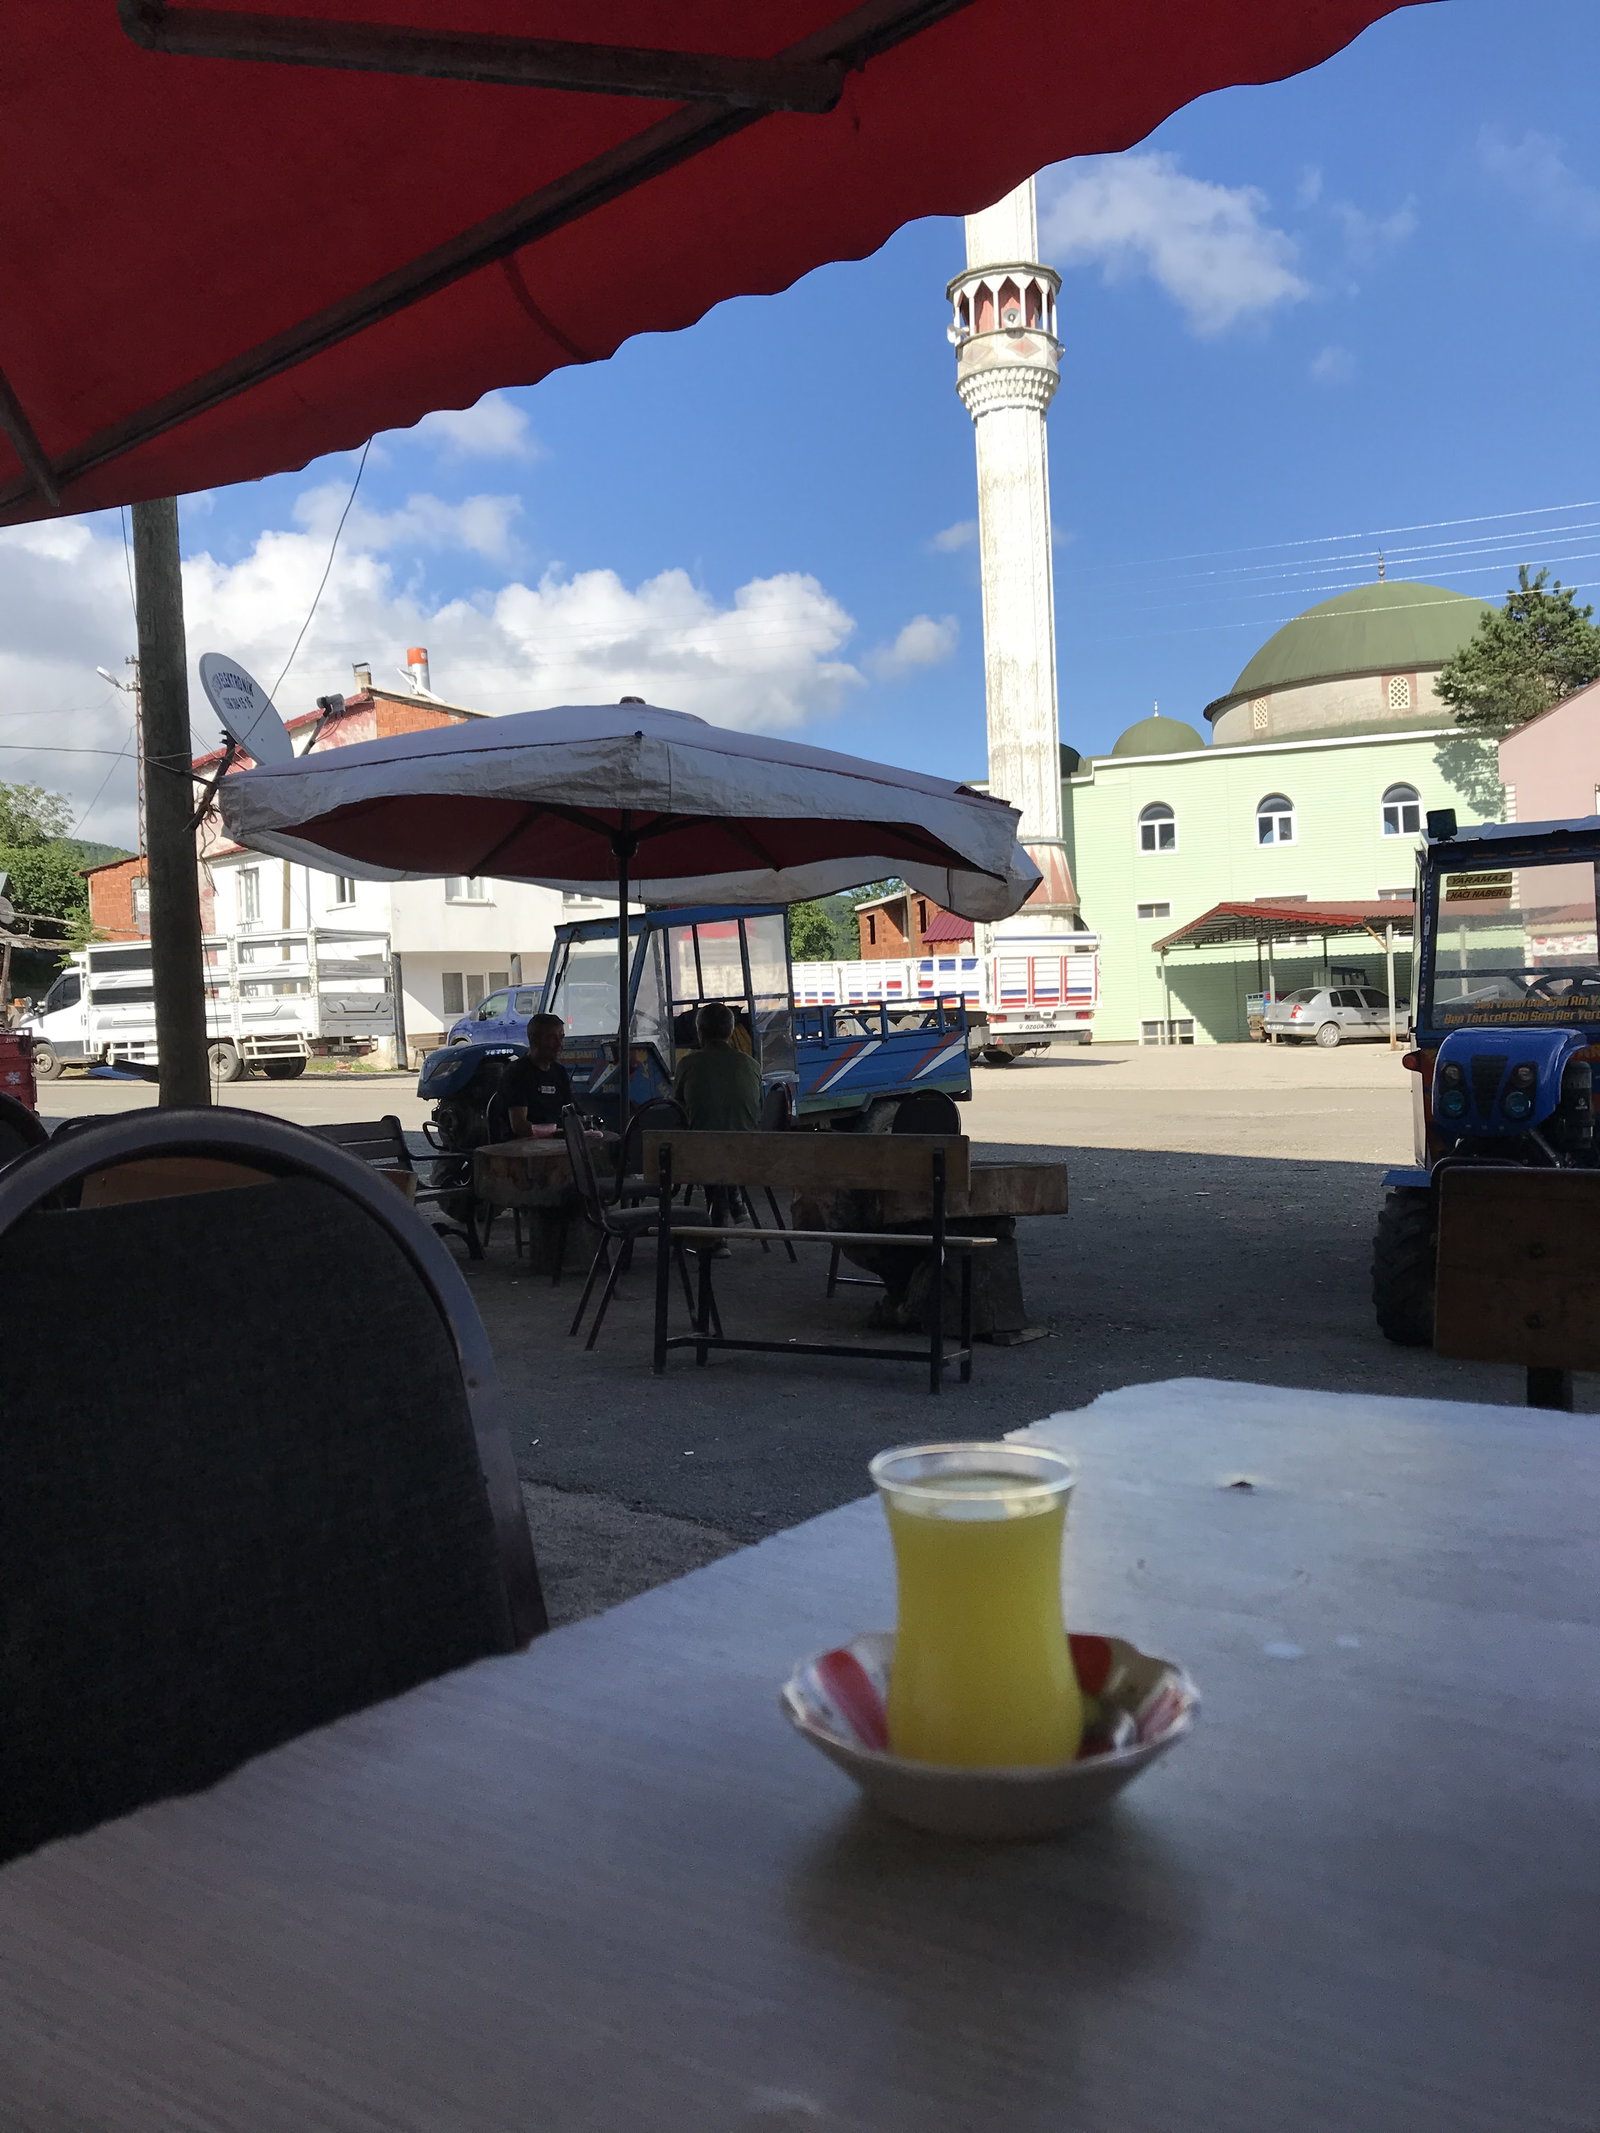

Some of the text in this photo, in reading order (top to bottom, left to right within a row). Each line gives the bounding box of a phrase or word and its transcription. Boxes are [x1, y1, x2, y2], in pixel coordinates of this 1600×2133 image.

[1451, 875, 1507, 884] YARAMAZ
[1450, 890, 1471, 899] HACI
[1509, 1011, 1530, 1022] Gibi
[1555, 1010, 1576, 1020] Her
